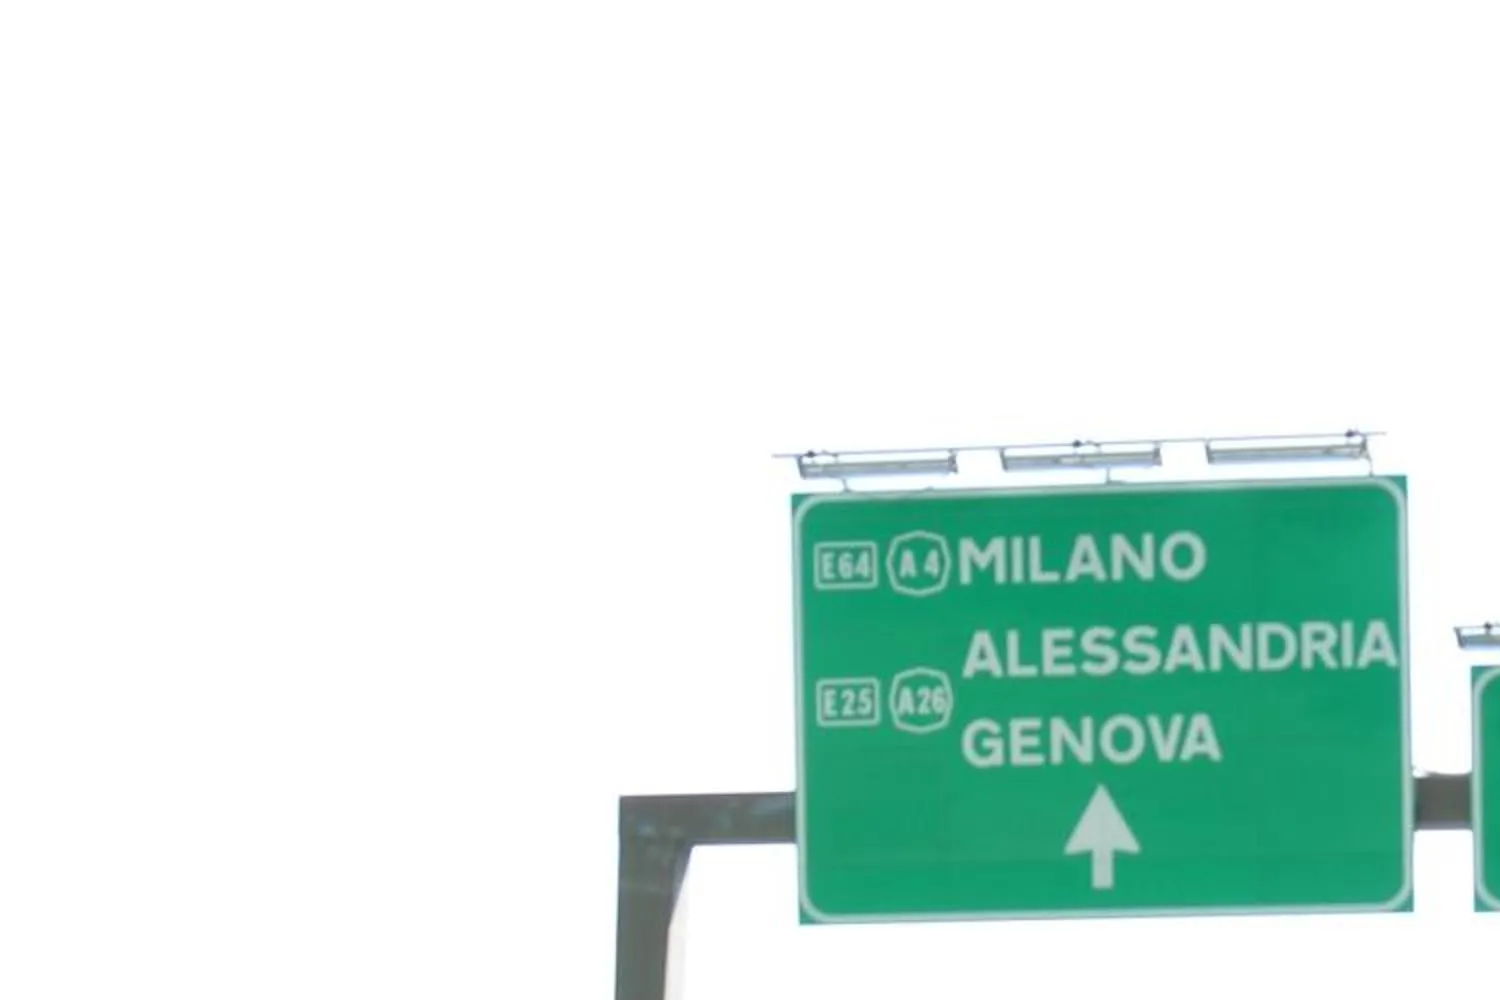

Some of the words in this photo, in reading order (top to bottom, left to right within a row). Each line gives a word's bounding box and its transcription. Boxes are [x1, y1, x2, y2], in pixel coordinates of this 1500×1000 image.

[822, 551, 870, 580] E64
[959, 531, 1206, 584] MILANO
[962, 621, 1399, 677] ALESSANDRIA
[823, 686, 873, 718] E25
[899, 685, 948, 716] A26
[962, 713, 1222, 767] GENOVA
